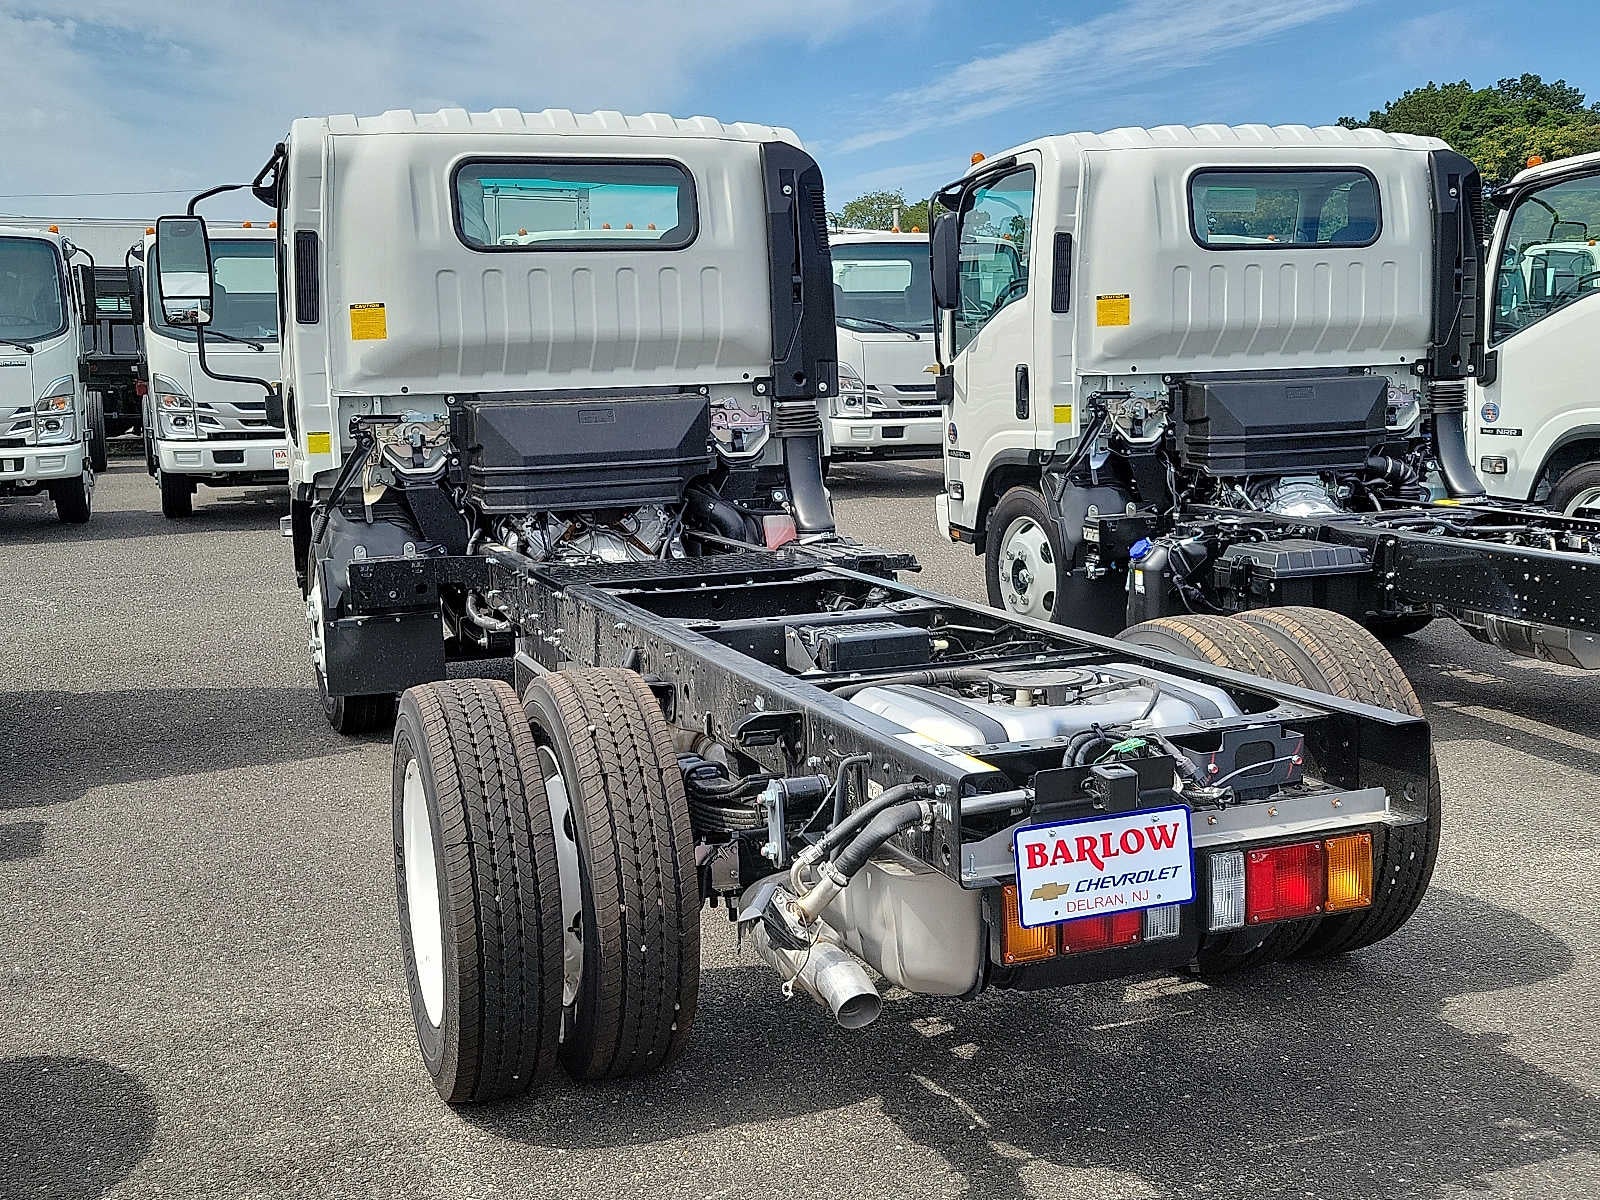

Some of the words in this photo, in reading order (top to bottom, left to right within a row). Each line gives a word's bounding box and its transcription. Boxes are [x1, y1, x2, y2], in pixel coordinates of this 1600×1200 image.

[1496, 428, 1518, 436] NRR
[1025, 823, 1180, 872] BARLOW
[1075, 865, 1183, 893] CHEVROLET
[1066, 893, 1128, 913] DELRAN,
[1132, 890, 1150, 903] NJ
